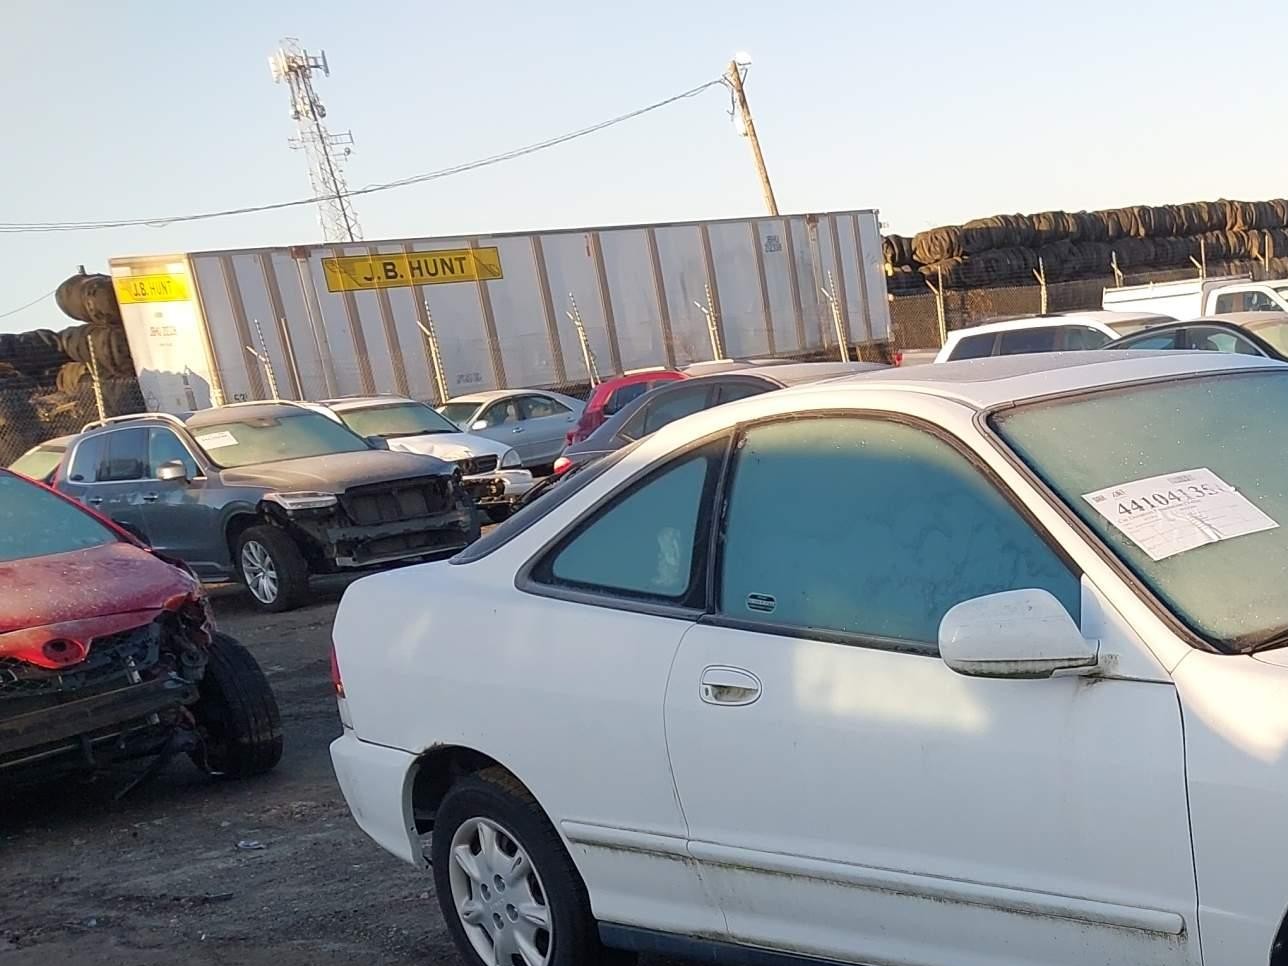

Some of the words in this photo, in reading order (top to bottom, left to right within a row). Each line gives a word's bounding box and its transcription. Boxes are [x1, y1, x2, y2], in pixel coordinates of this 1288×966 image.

[363, 261, 404, 282] J.B.
[410, 256, 466, 278] HUNT
[134, 281, 149, 297] J.B.
[150, 280, 172, 296] HUNT
